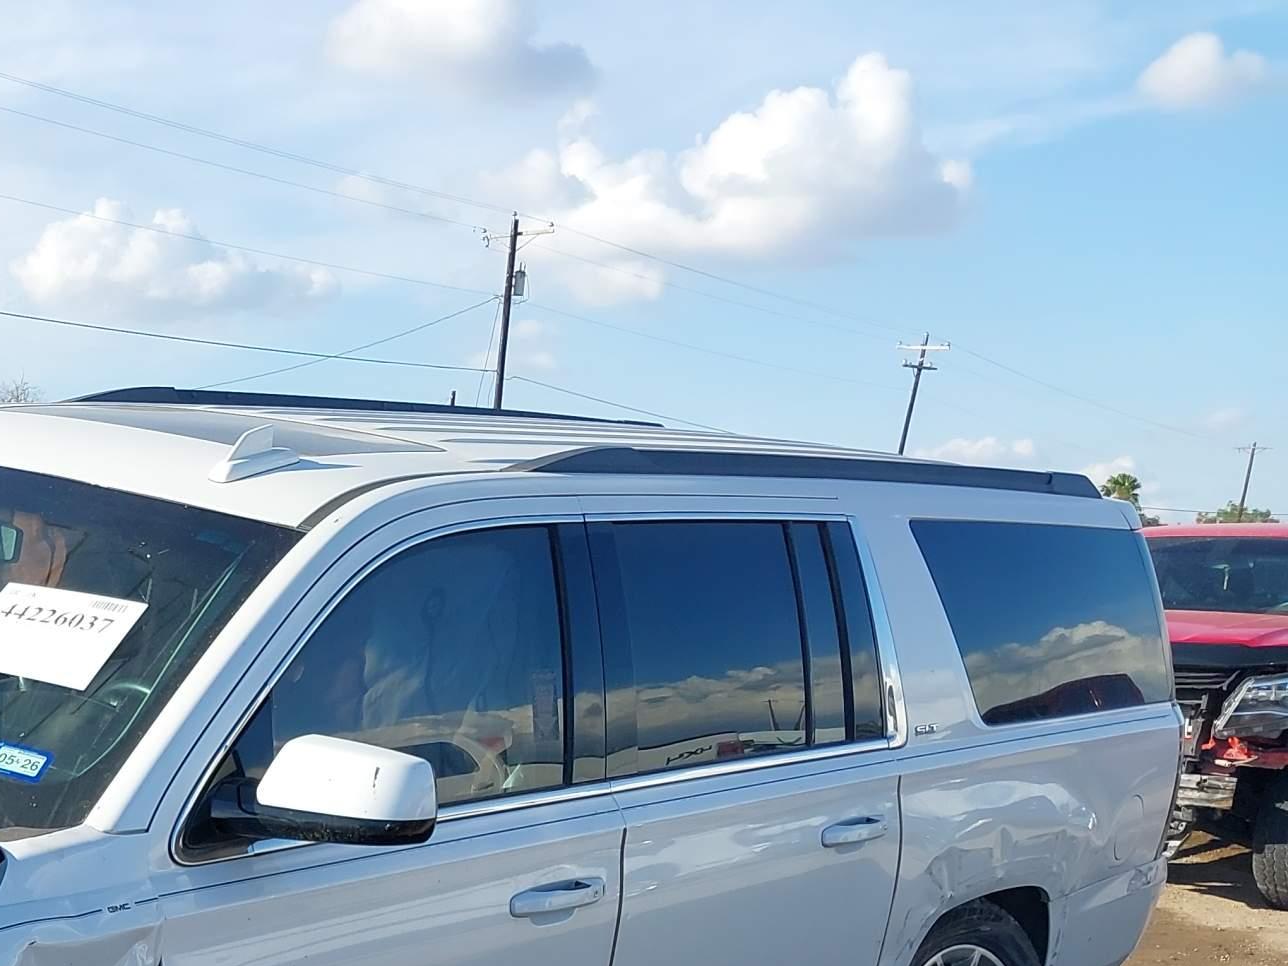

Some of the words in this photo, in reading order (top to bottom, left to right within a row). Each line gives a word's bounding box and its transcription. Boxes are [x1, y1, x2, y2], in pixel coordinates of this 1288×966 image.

[1, 603, 115, 633] 44226037
[19, 758, 41, 771] 26
[107, 903, 131, 913] GMC
